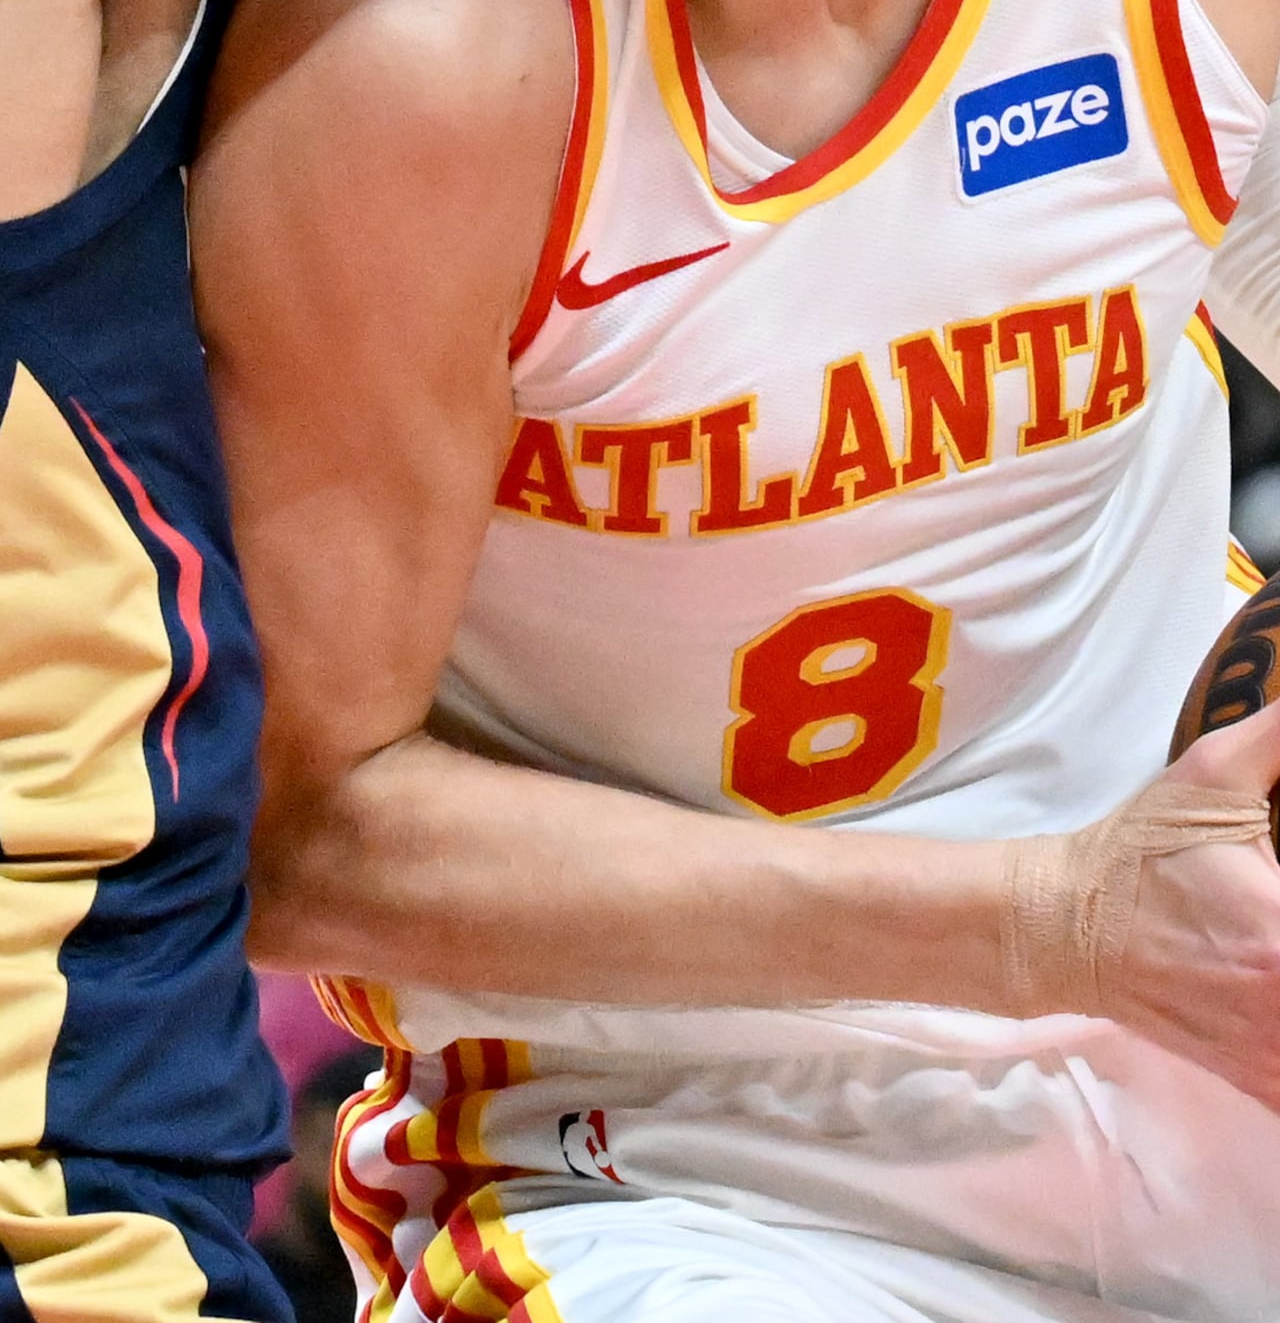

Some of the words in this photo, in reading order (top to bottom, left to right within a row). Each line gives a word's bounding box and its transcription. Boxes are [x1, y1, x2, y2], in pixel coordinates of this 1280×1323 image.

[966, 84, 1109, 172] paze
[493, 283, 1150, 538] ATLANTA
[721, 586, 953, 824] 8
